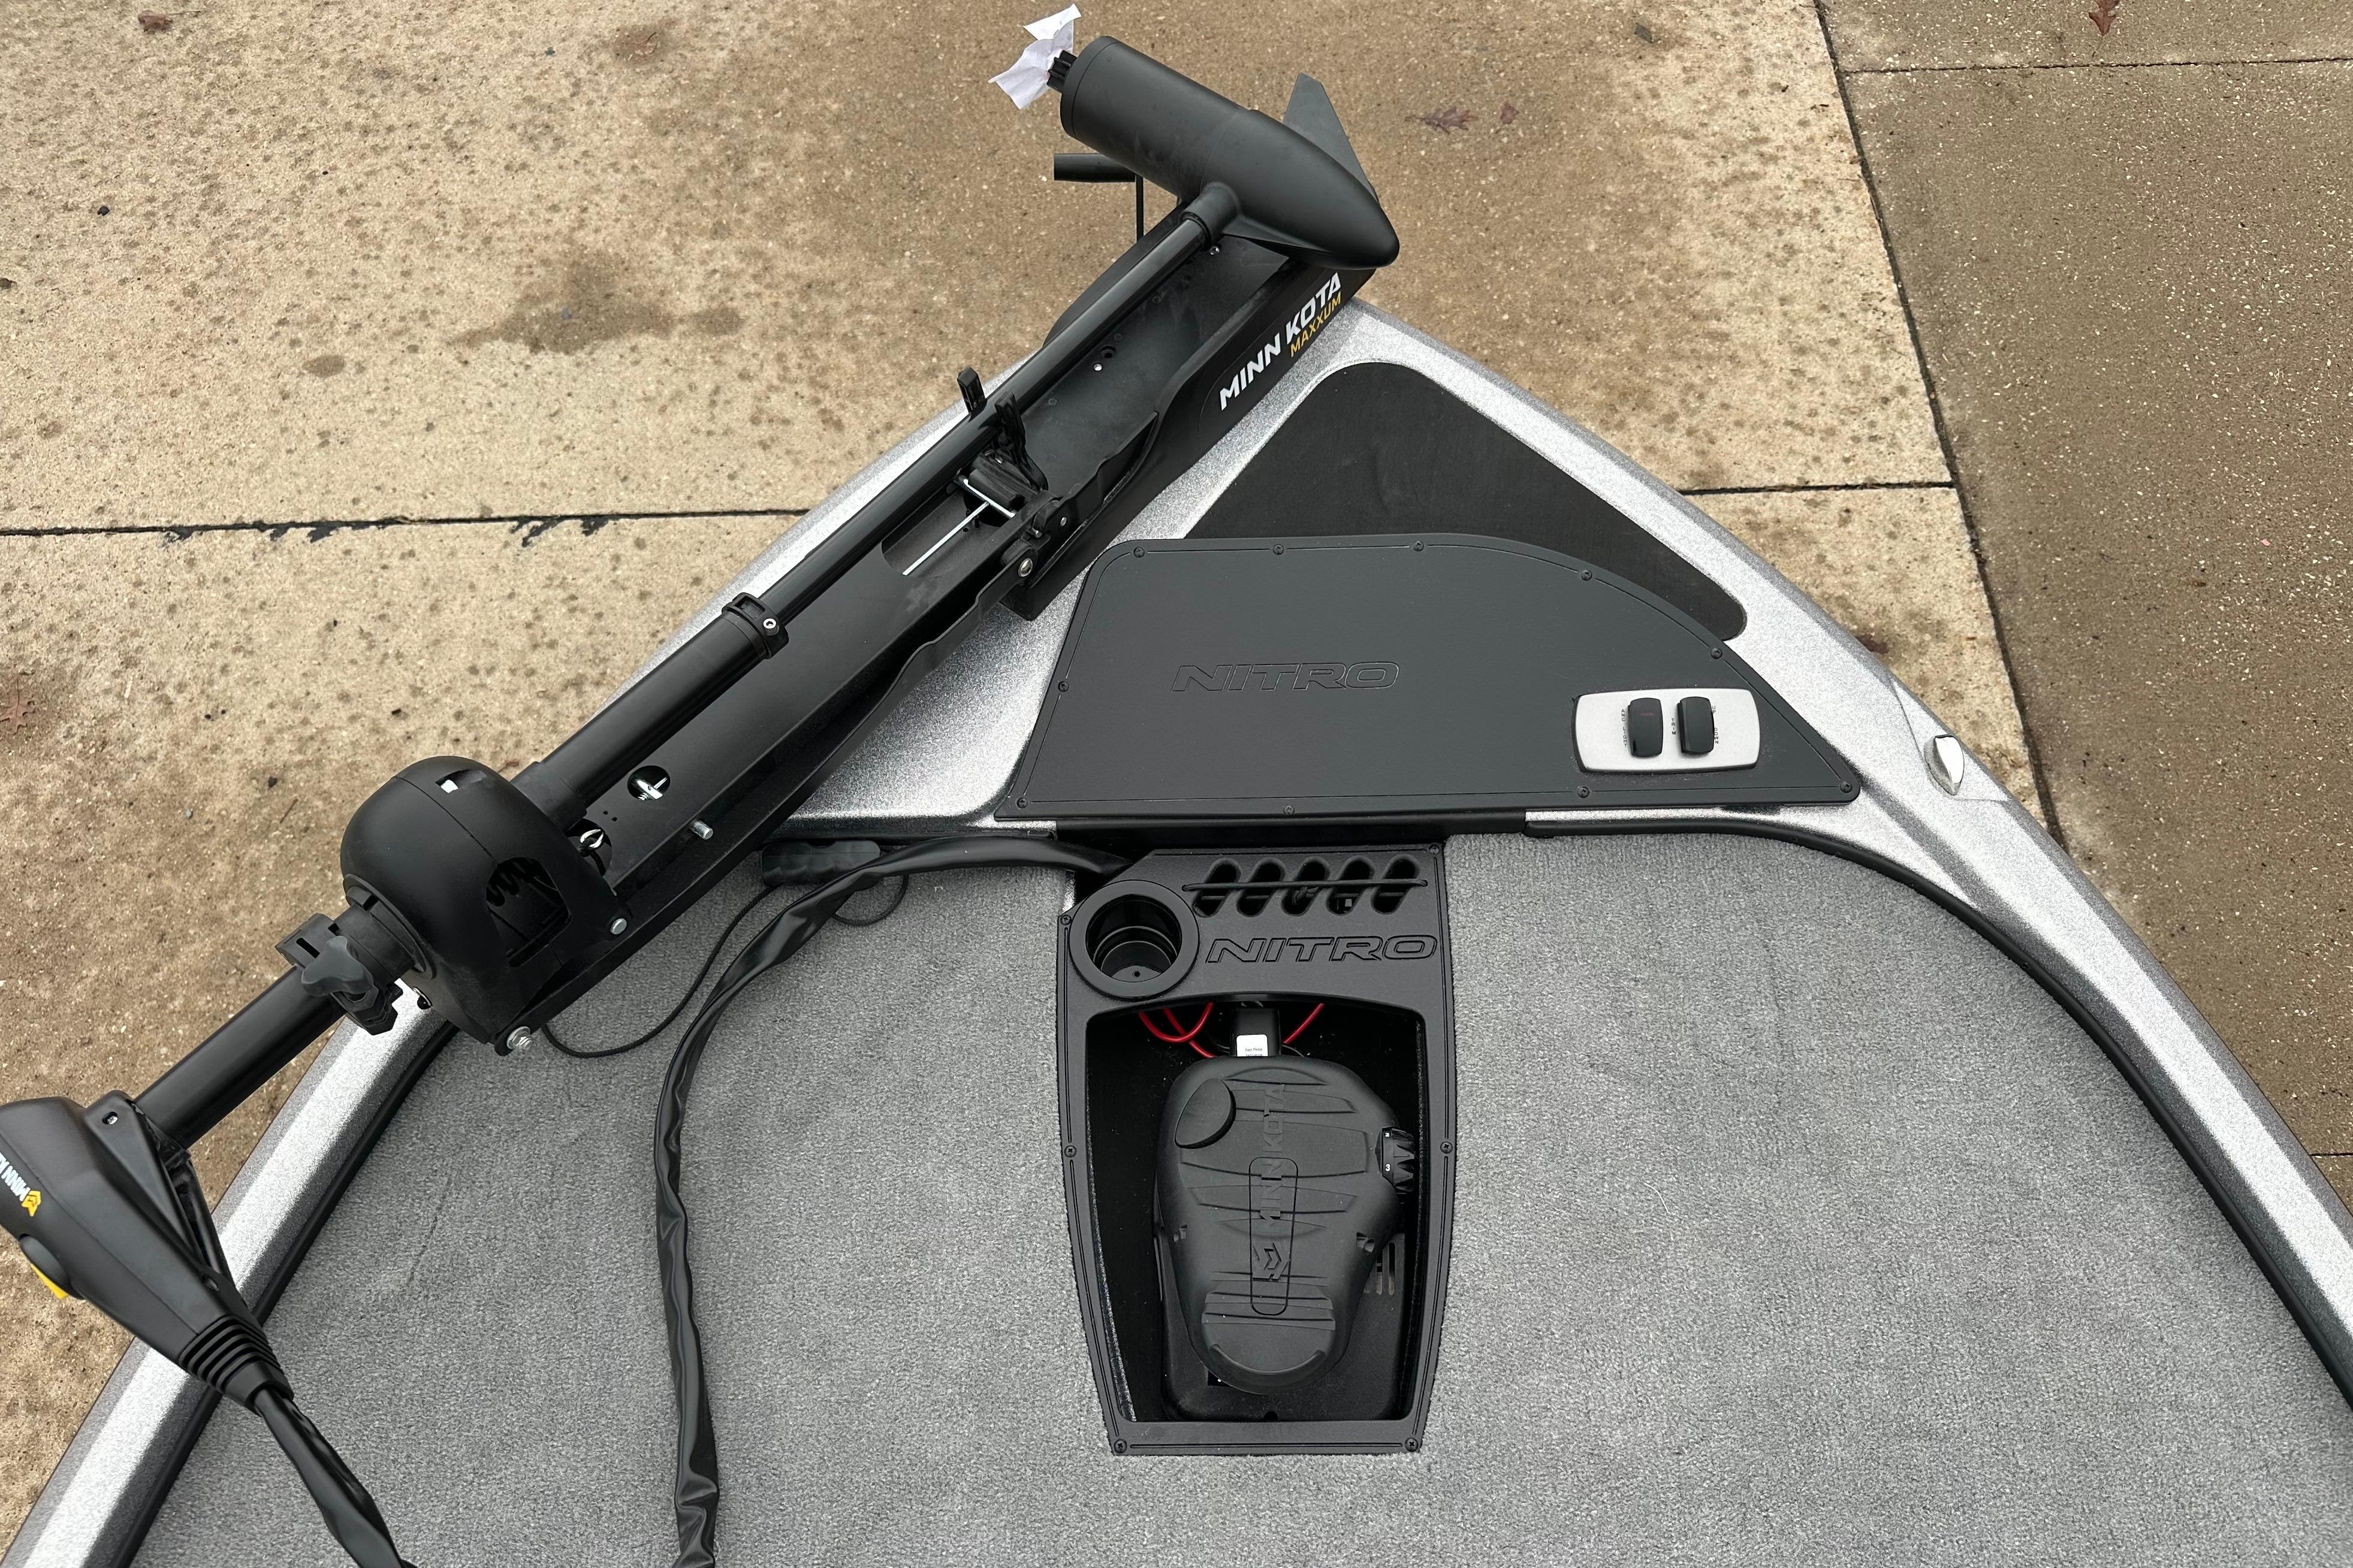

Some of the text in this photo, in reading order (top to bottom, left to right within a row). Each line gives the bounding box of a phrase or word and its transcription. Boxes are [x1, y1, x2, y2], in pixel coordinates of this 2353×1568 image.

[1220, 272, 1341, 411] MINN KOTA
[1290, 291, 1341, 358] MAXXUM
[1171, 661, 1399, 693] NITRO
[1712, 705, 1717, 714] UP
[1205, 934, 1438, 963] NITRO
[1260, 1083, 1285, 1233] MINN KOTA
[1, 1165, 31, 1202] MINN
